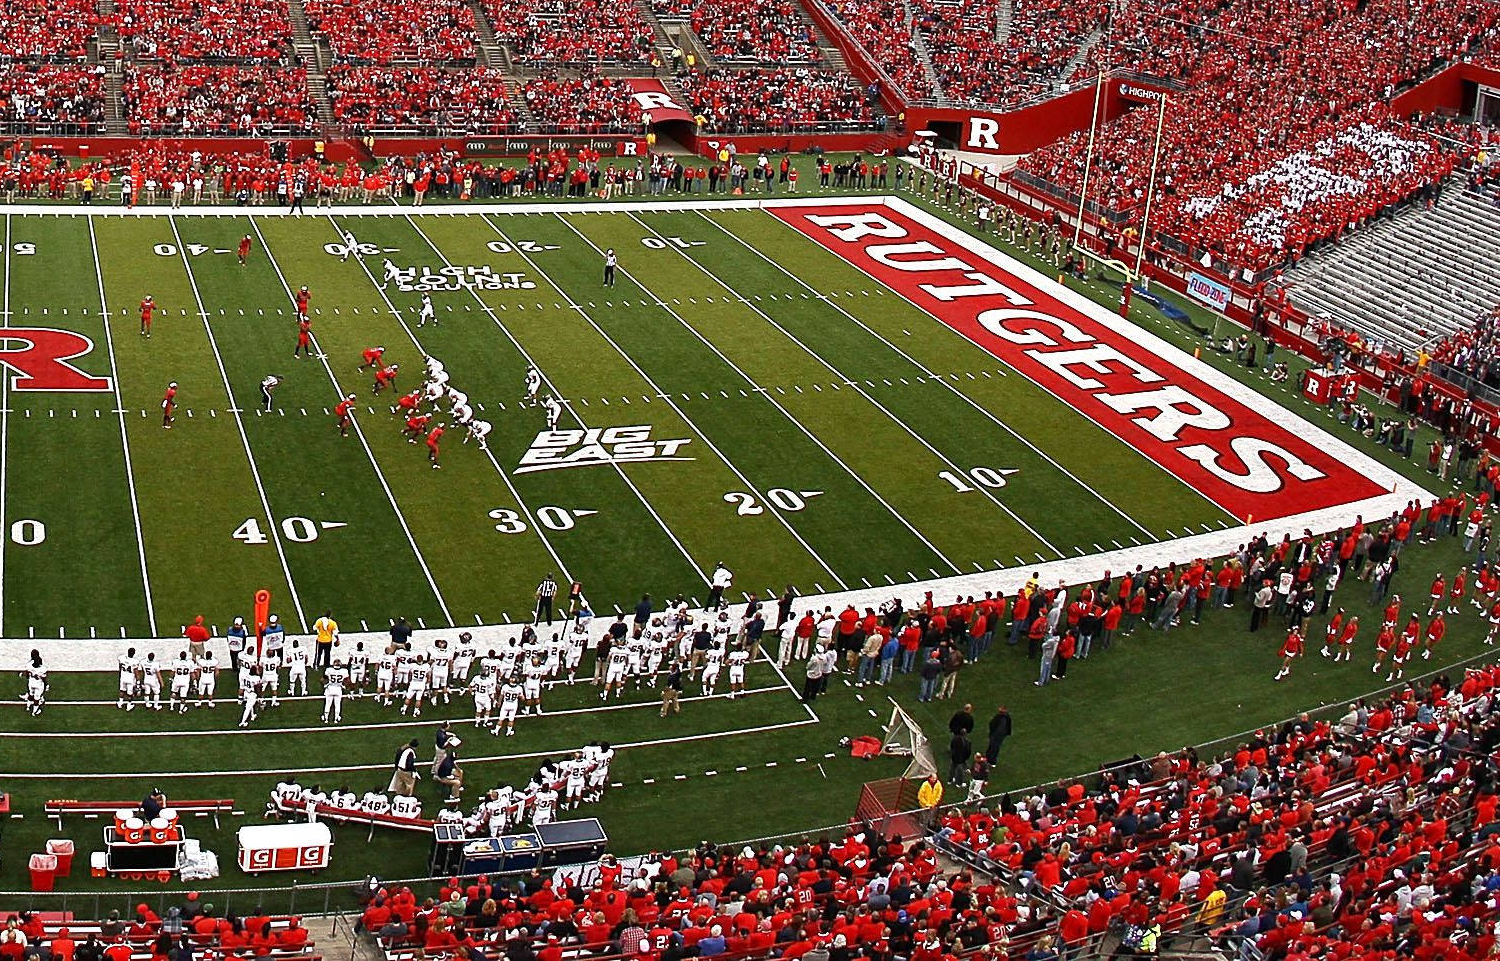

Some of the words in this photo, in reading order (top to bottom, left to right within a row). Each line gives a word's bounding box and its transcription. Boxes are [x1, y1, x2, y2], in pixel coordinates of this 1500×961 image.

[631, 91, 684, 111] R
[967, 117, 1000, 149] R
[623, 141, 637, 156] R
[396, 273, 526, 286] POINT
[398, 282, 537, 292] SOLUTIONS
[803, 211, 1328, 493] RUTGERS
[1306, 378, 1320, 396] R
[530, 425, 652, 448] BIG
[518, 438, 692, 465] EAST
[937, 466, 1007, 495] 10
[723, 487, 806, 517] 20
[488, 505, 574, 534] 30
[231, 516, 319, 545] 40
[436, 658, 449, 667] 77
[330, 674, 343, 683] 52
[413, 670, 426, 679] 55
[337, 798, 345, 809] 6
[367, 800, 381, 811] 48
[397, 802, 410, 813] 51
[253, 849, 269, 863] G
[304, 846, 319, 861] G
[799, 890, 812, 903] 20
